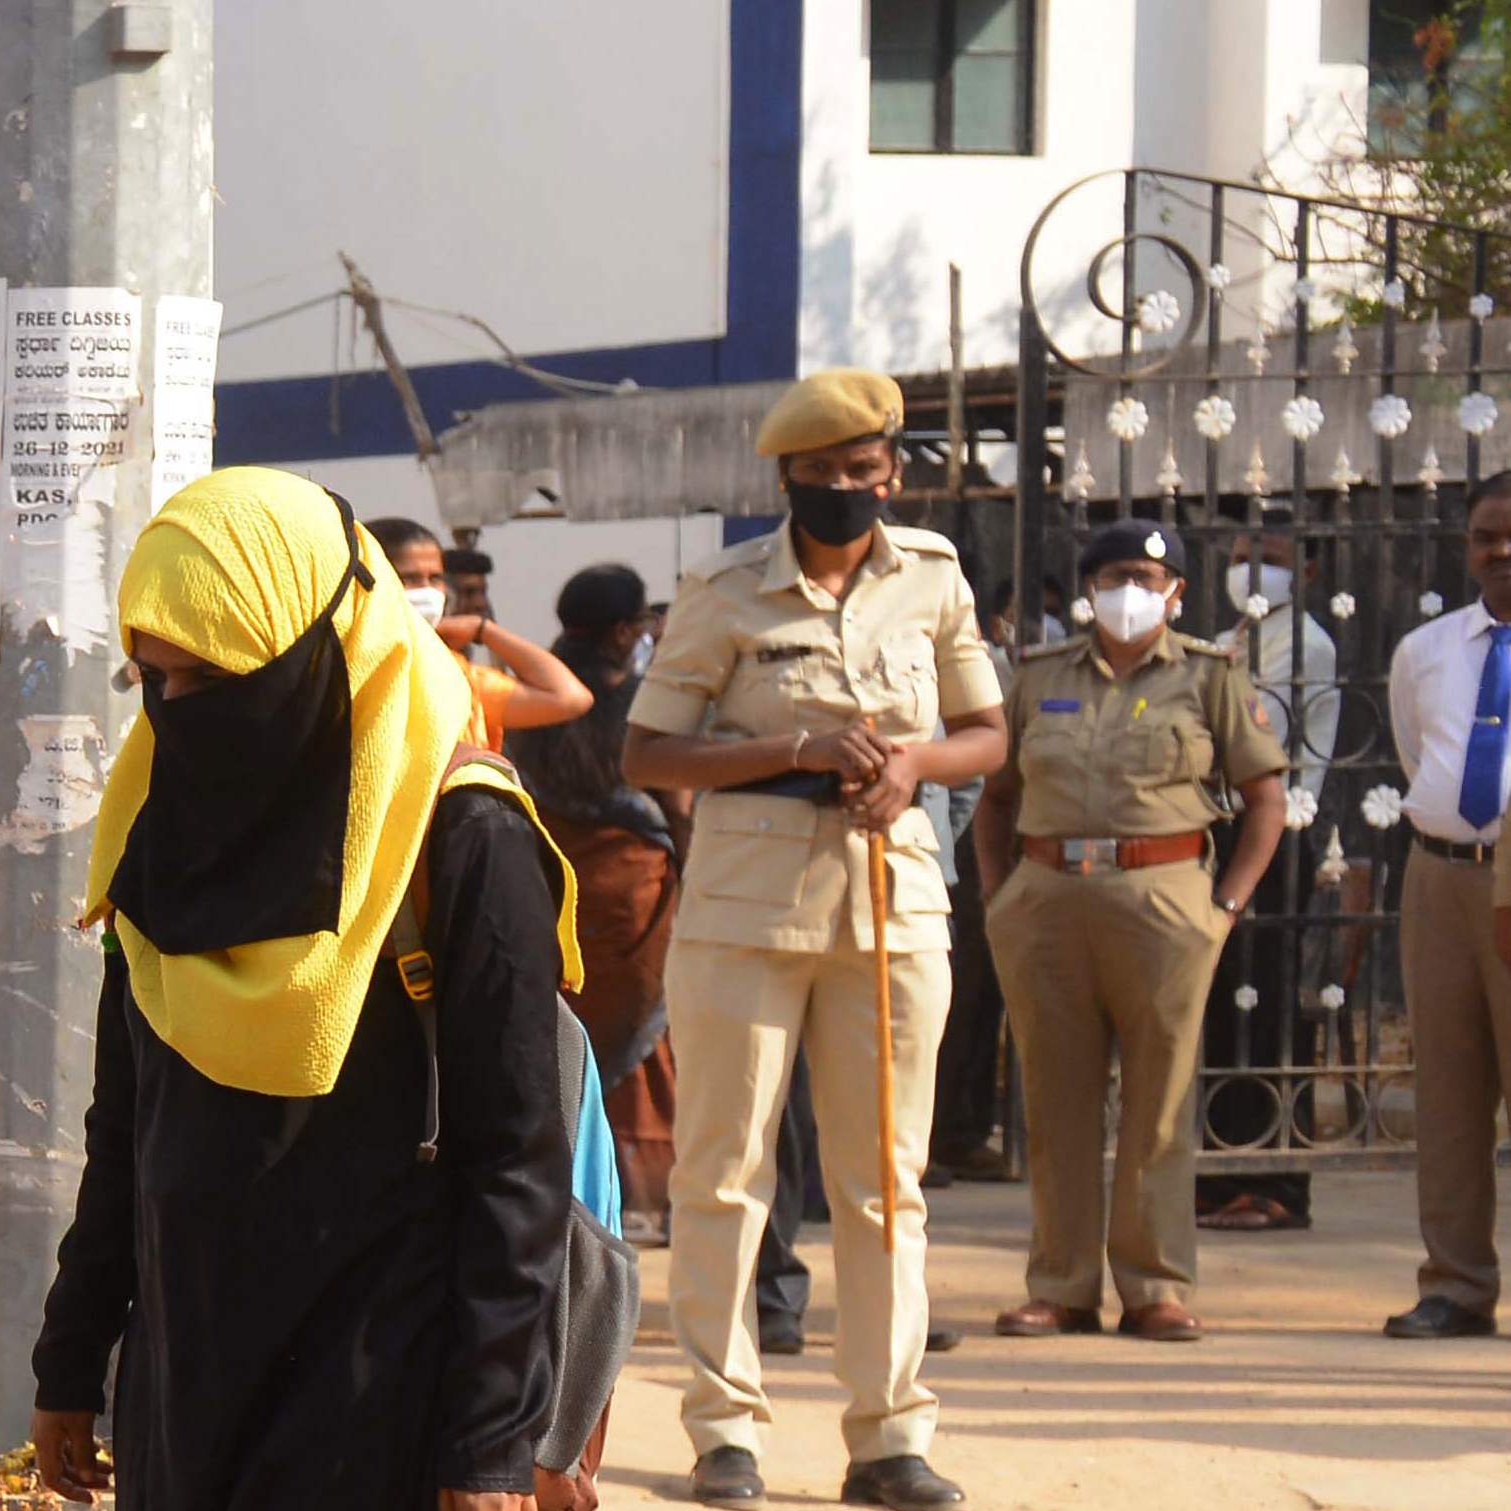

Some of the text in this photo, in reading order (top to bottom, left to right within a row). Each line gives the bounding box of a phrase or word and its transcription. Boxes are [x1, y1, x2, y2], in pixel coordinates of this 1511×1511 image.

[16, 311, 131, 327] FREE CLASSES
[13, 441, 124, 456] 26-12-2021
[16, 489, 72, 506] KAS,
